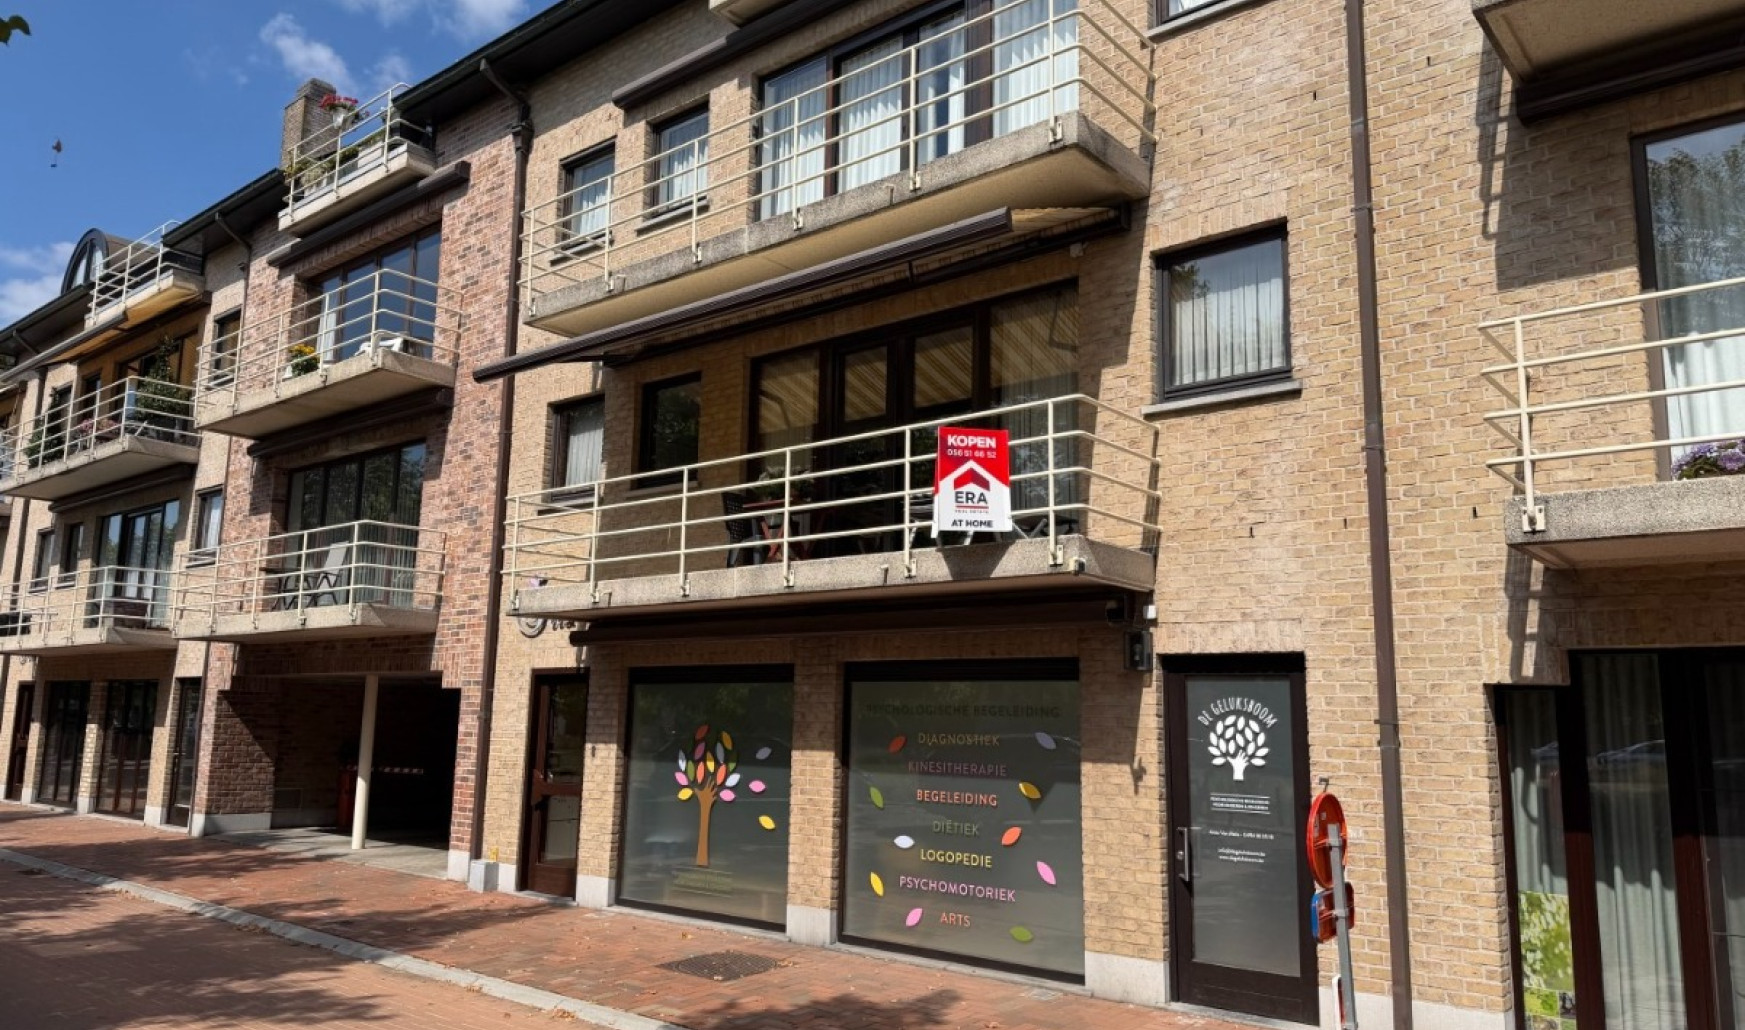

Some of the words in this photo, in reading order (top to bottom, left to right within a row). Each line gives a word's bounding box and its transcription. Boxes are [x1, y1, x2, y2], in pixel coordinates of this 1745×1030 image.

[947, 434, 996, 448] KOPEN
[955, 491, 987, 504] ERA
[952, 519, 963, 527] AT
[966, 520, 993, 528] HOME
[973, 704, 1061, 719] BEGELEIDING
[1210, 697, 1277, 728] GELUKSBOOM
[908, 761, 1006, 777] KINESITHERAPIE
[916, 789, 997, 807] BEGELEIDING
[933, 820, 980, 836] DIËTIEK
[920, 848, 992, 868] LOGOPEDIE
[899, 876, 1016, 902] PSYCHOMOTORIEK
[940, 912, 972, 928] ARTS
